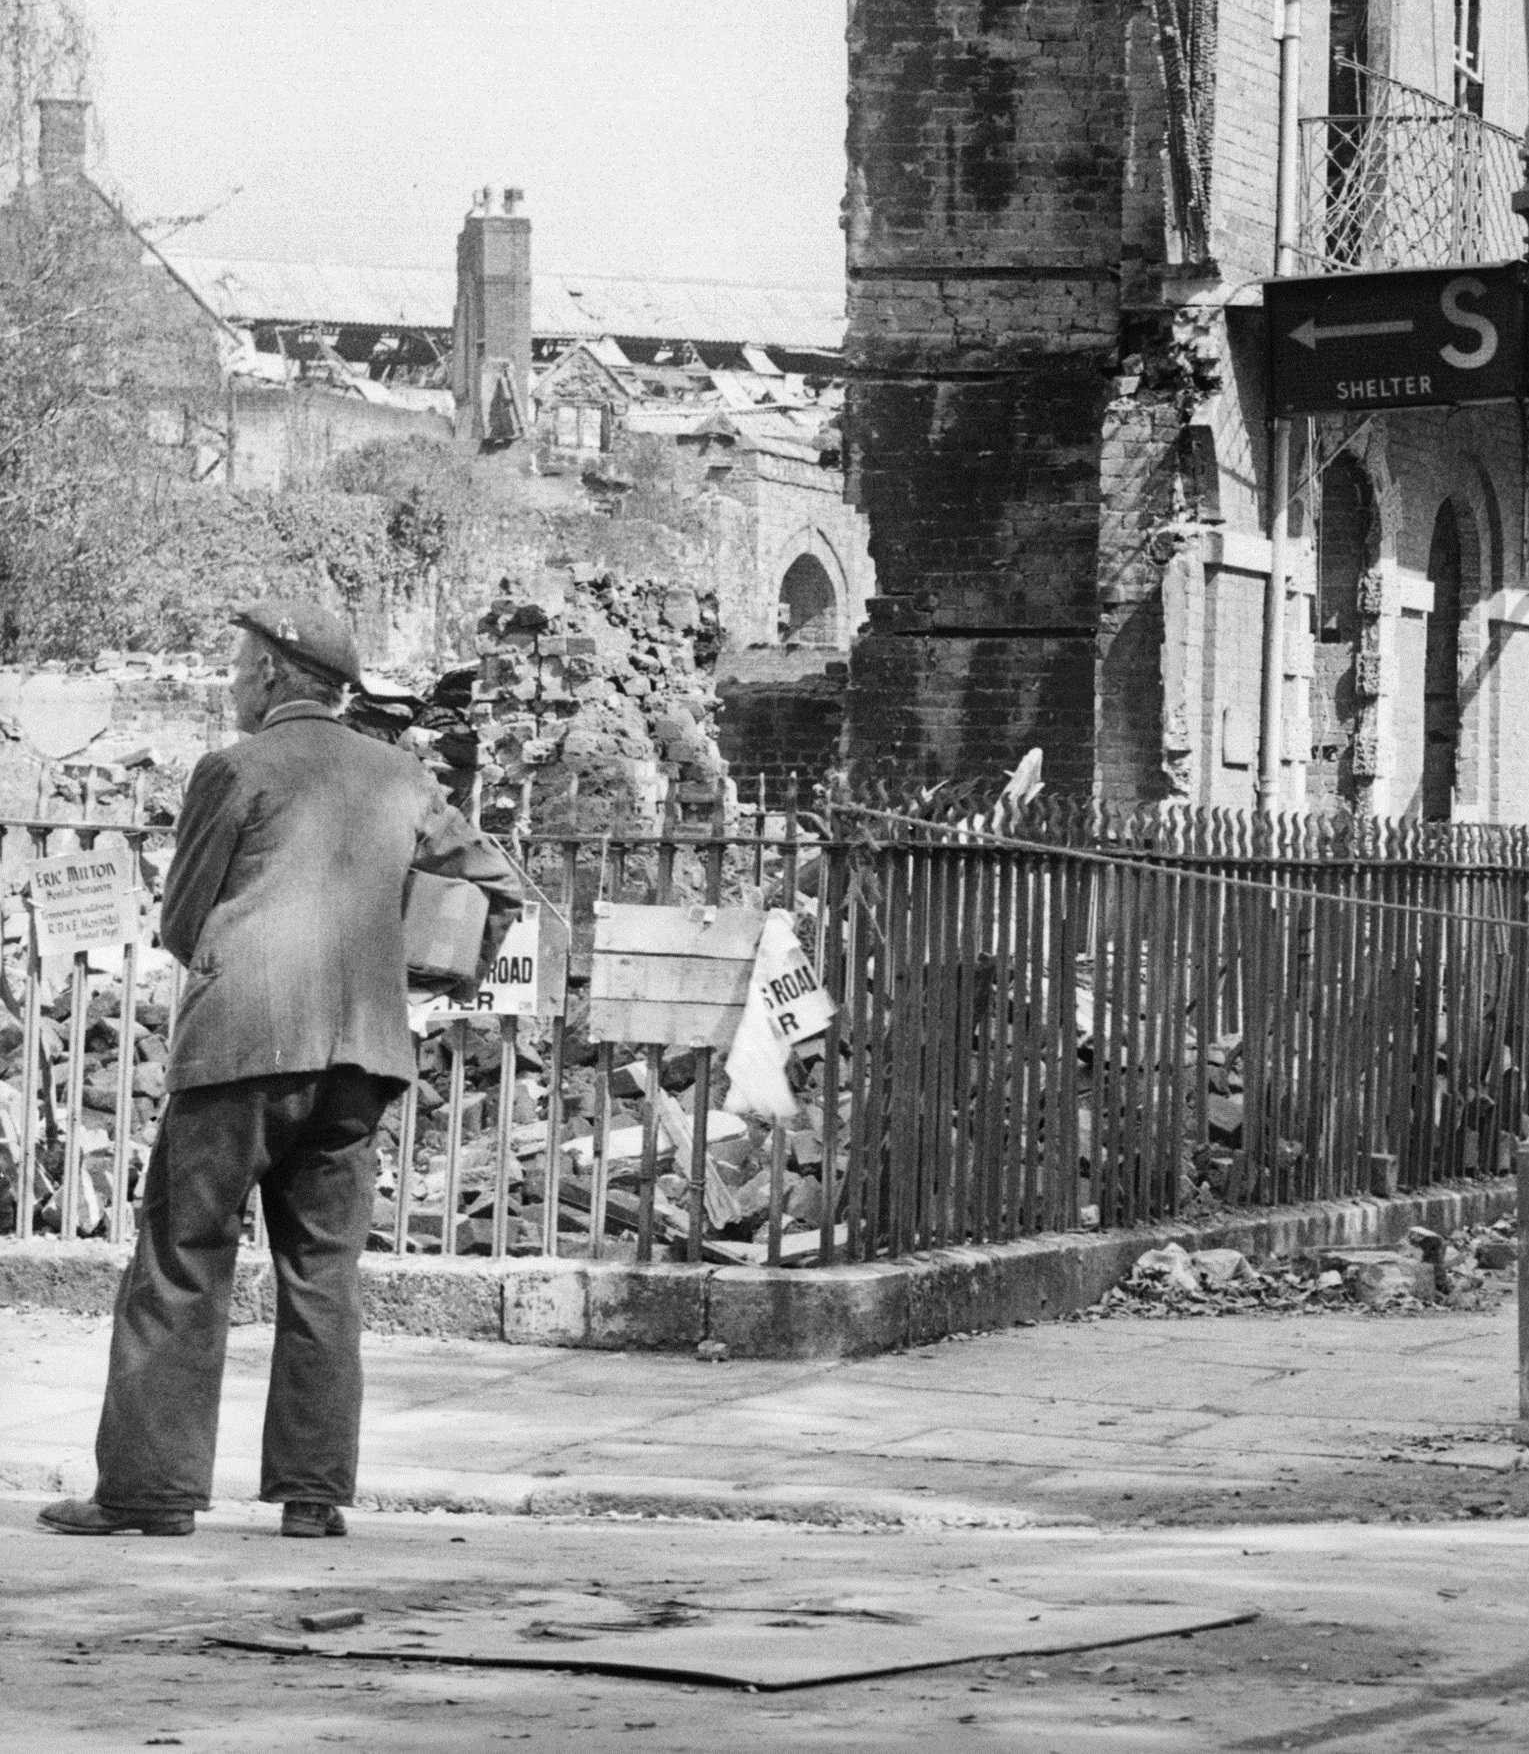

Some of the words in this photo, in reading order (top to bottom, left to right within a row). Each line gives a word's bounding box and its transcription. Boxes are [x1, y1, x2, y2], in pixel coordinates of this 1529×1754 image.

[1440, 276, 1498, 369] S
[1336, 375, 1433, 400] SHELTER
[35, 871, 62, 888] ERIC
[66, 862, 116, 882] MILTON
[486, 956, 533, 984] ROAD
